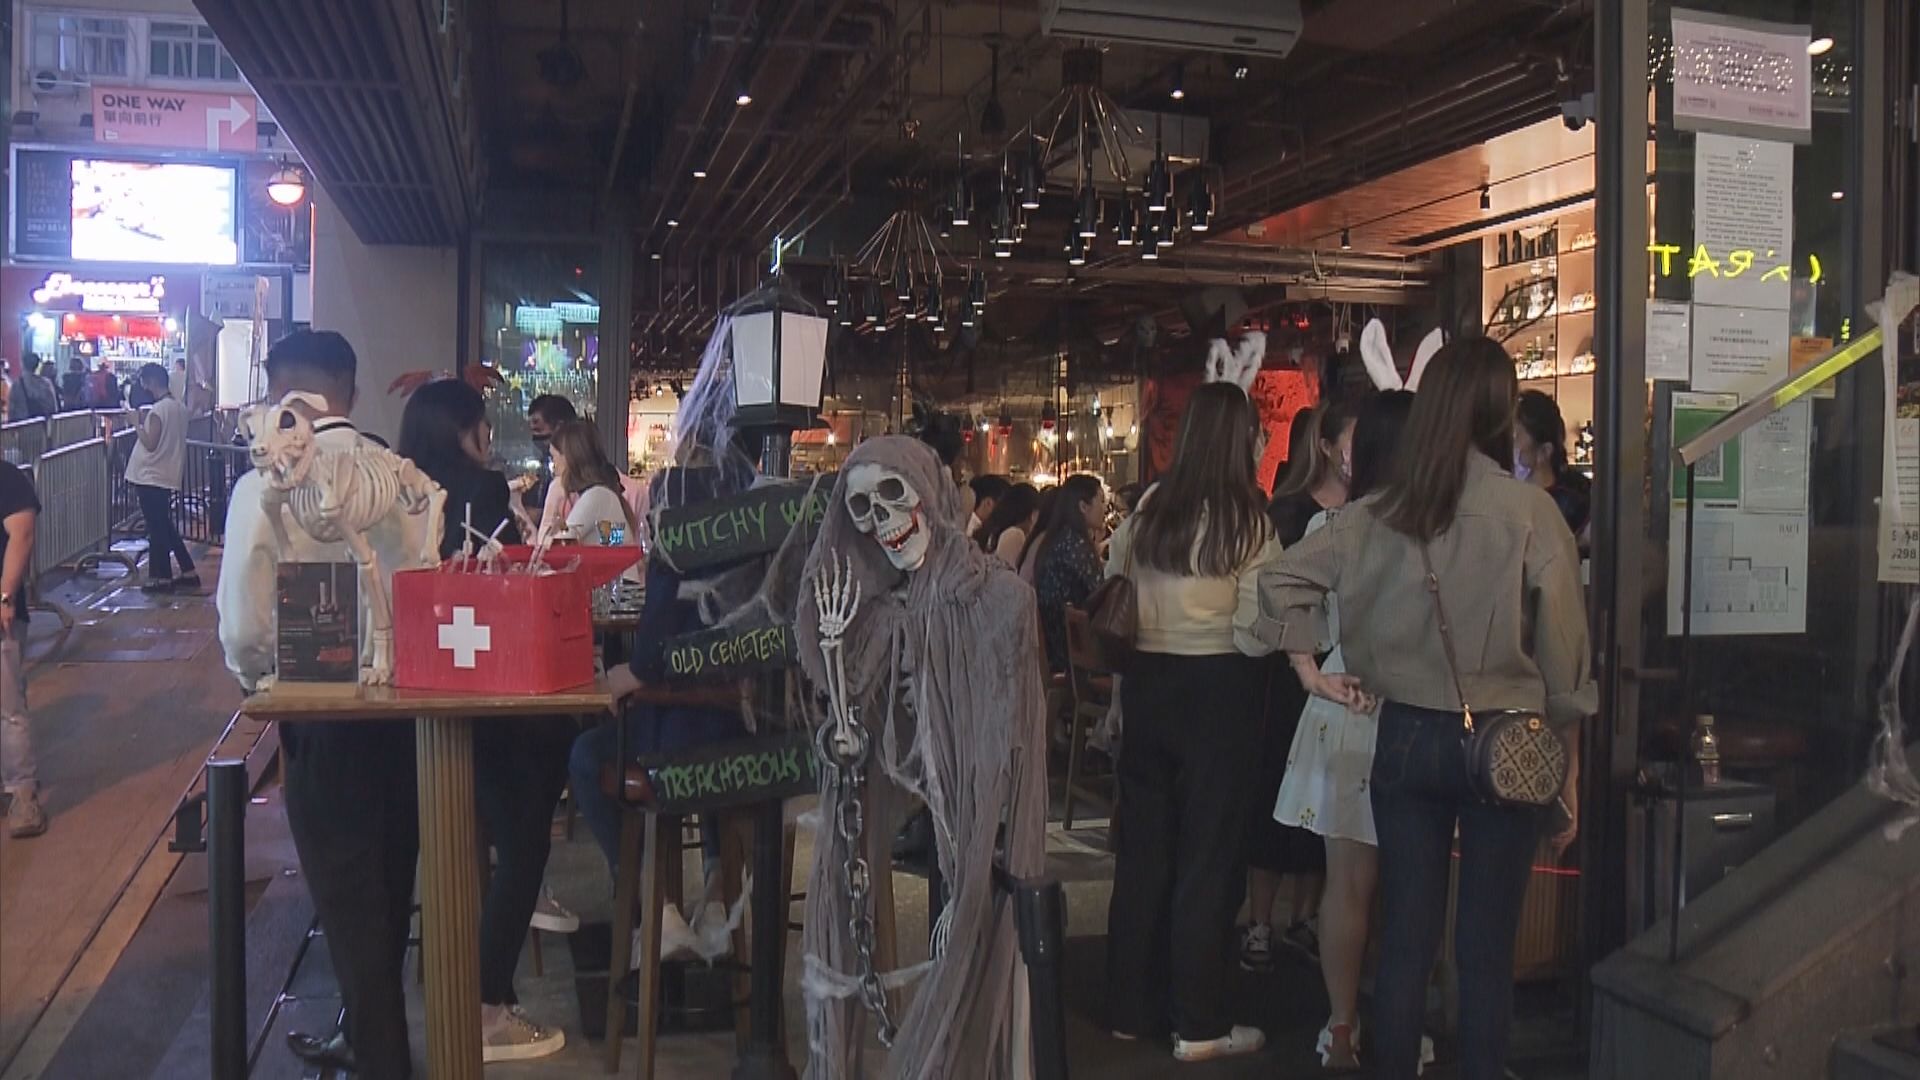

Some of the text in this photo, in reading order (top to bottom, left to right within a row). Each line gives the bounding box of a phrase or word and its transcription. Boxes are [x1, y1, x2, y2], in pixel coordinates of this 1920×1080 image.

[102, 94, 186, 112] ONE WAY
[659, 502, 768, 552] WITCHY
[671, 625, 787, 675] OLD CEMETERY
[659, 747, 801, 800] TREACHEROUS
